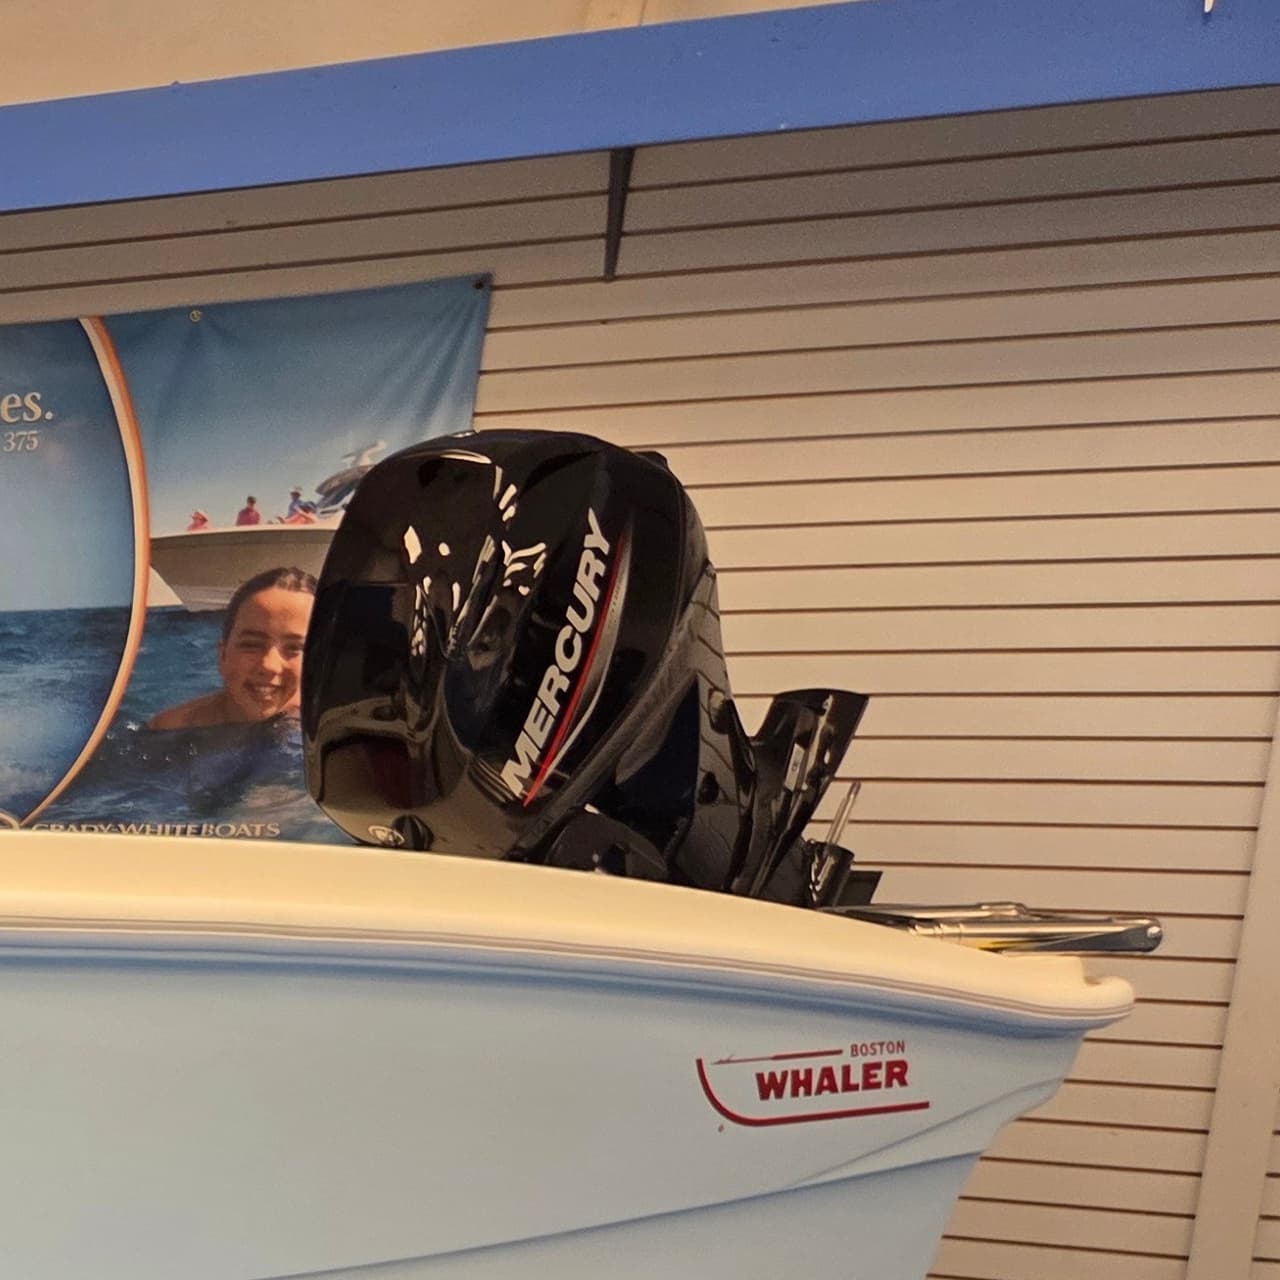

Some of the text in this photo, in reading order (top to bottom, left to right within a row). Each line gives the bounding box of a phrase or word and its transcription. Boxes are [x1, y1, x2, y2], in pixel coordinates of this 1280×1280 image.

[3, 430, 40, 452] 375
[500, 507, 611, 798] MERCURY
[200, 822, 281, 838] BOATS
[850, 1040, 906, 1058] BOSTON
[755, 1059, 909, 1102] WHALER
